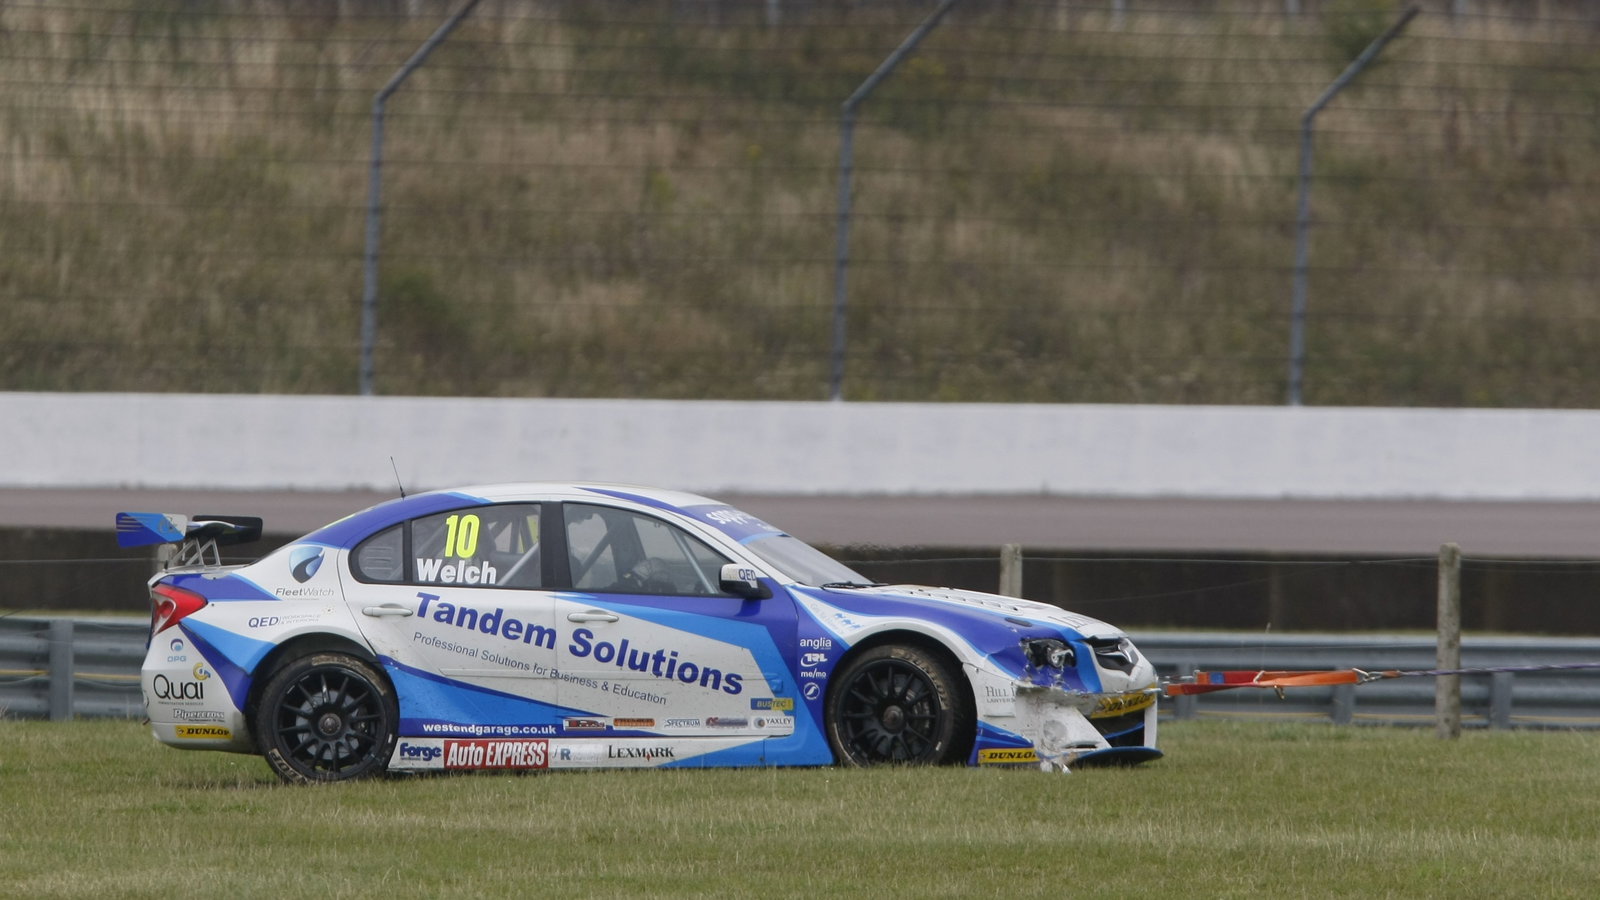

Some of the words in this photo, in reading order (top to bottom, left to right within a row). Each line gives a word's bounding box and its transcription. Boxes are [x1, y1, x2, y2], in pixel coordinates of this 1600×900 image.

[445, 514, 480, 559] 10
[416, 558, 497, 585] Welch
[738, 568, 757, 581] QED
[275, 588, 335, 596] FleetWatch
[248, 616, 279, 628] QED
[416, 592, 557, 650] Tandem
[568, 628, 743, 695] Solutions
[800, 637, 832, 650] anglia
[413, 631, 479, 658] Professional
[480, 650, 530, 671] Solutions
[533, 663, 548, 676] for
[549, 670, 598, 690] Business
[601, 682, 610, 692] &
[612, 683, 667, 705] Education
[985, 685, 1008, 697] HILL
[173, 708, 225, 720] Pipercross
[422, 723, 557, 736] westendgarage.co.uk
[665, 719, 701, 727] SPECTRUM
[186, 727, 230, 736] DUNLOP
[399, 742, 442, 762] Forge
[446, 742, 484, 767] Auto
[485, 741, 548, 766] EXPRESS
[608, 745, 675, 761] LEXMARK
